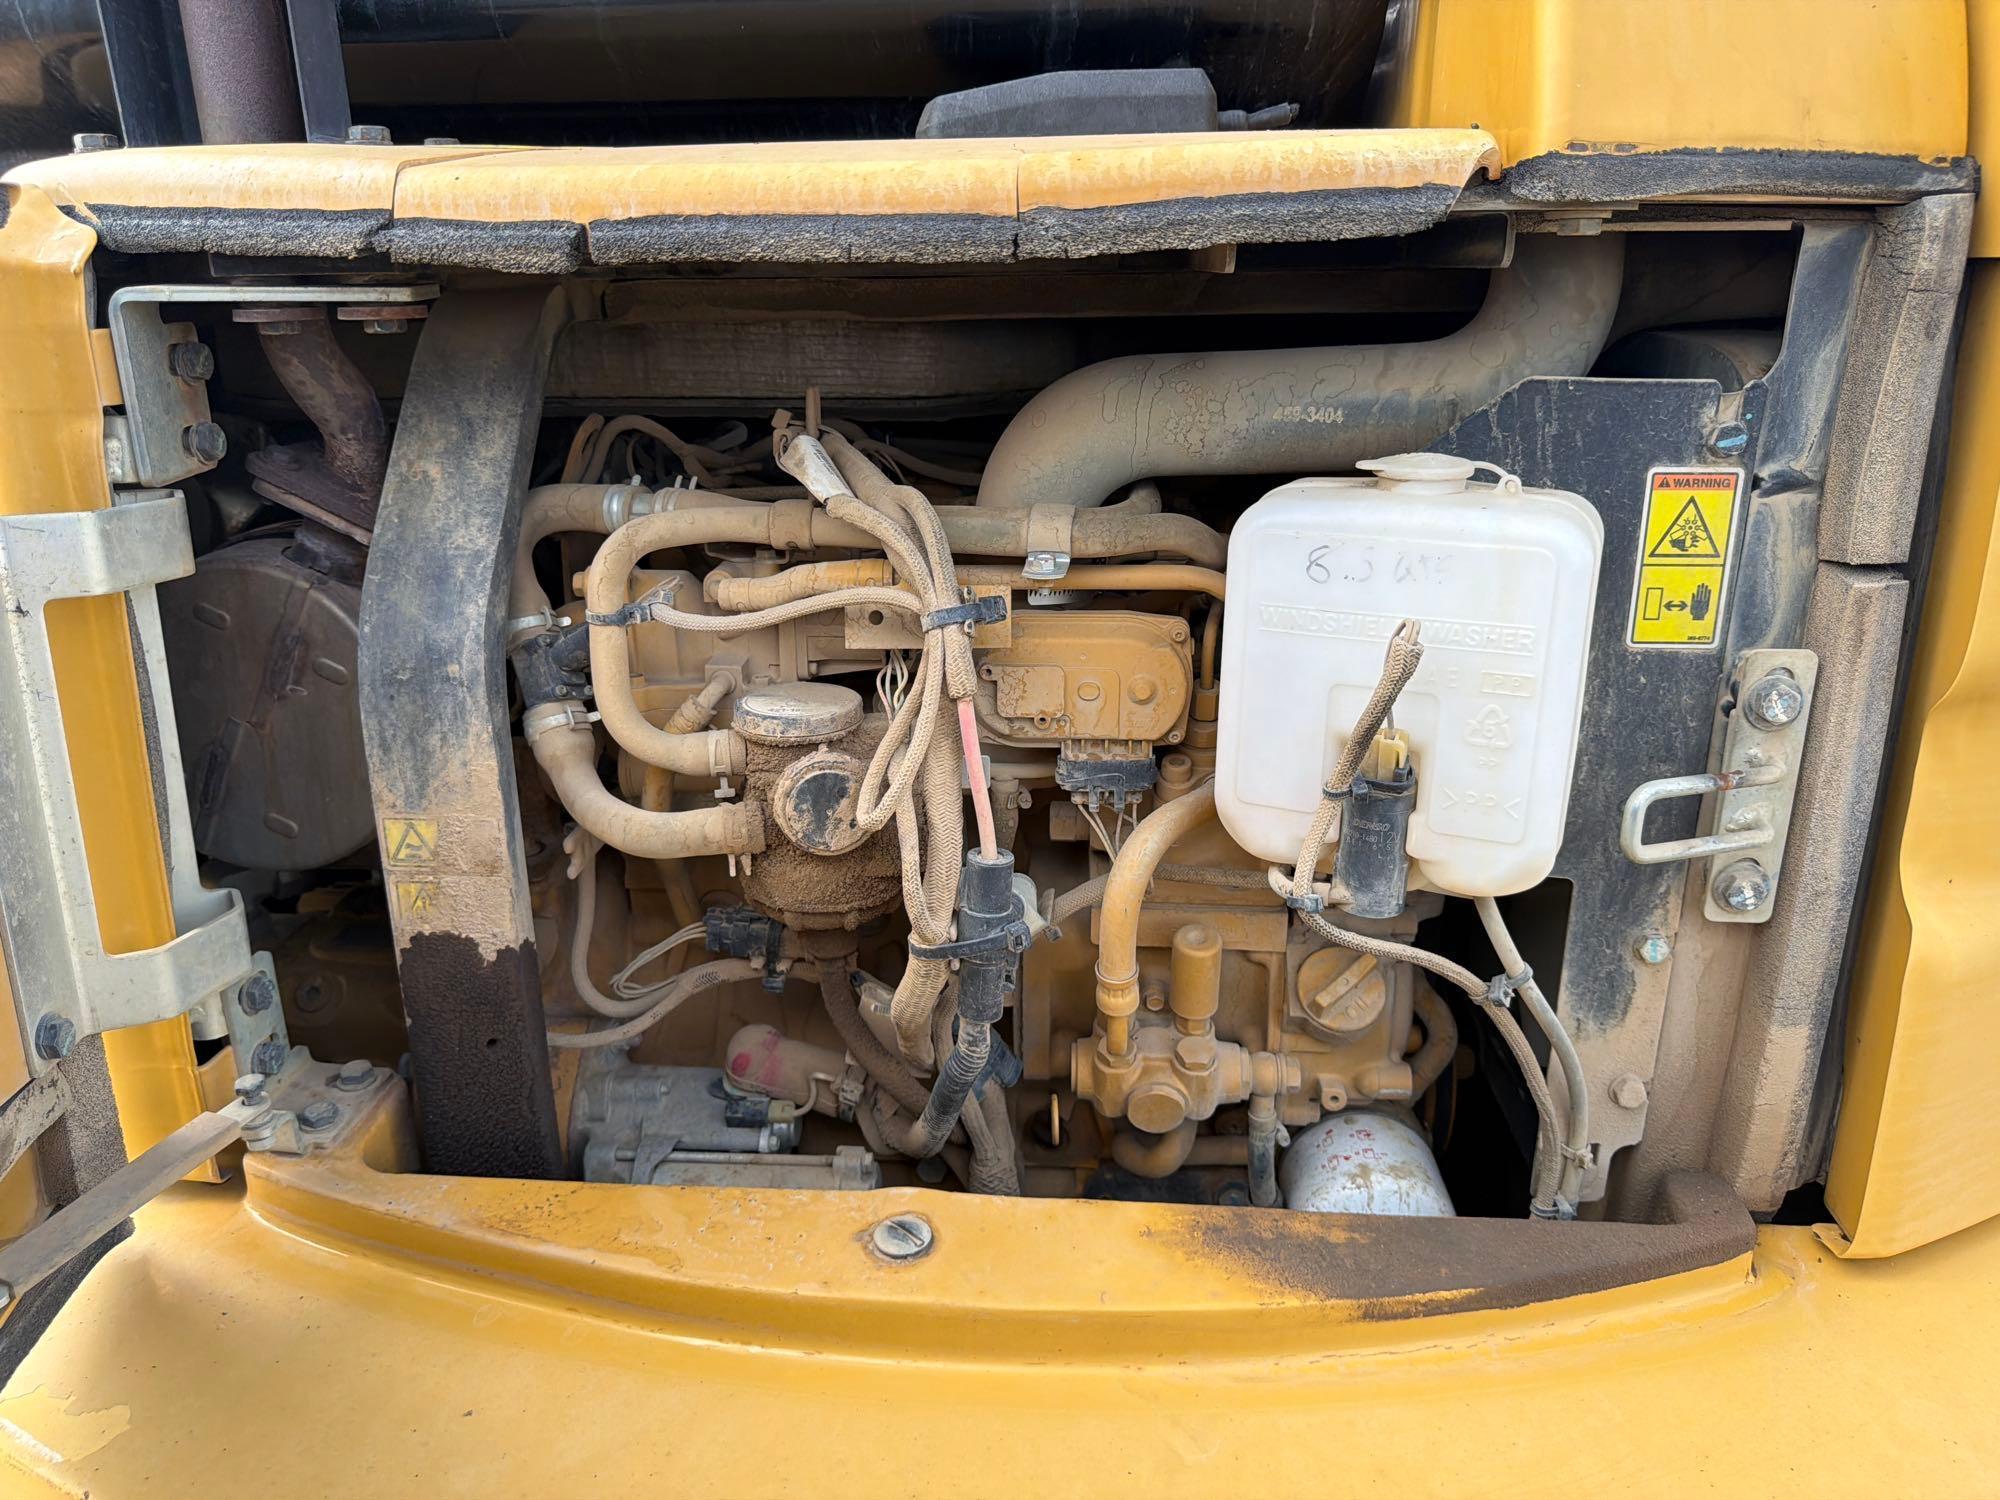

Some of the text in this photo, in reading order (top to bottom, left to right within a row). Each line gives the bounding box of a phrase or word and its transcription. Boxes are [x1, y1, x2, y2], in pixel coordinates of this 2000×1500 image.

[1272, 406, 1344, 424] 459-3404
[1673, 478, 1731, 489] WARNING
[1423, 619, 1536, 651] WASHER
